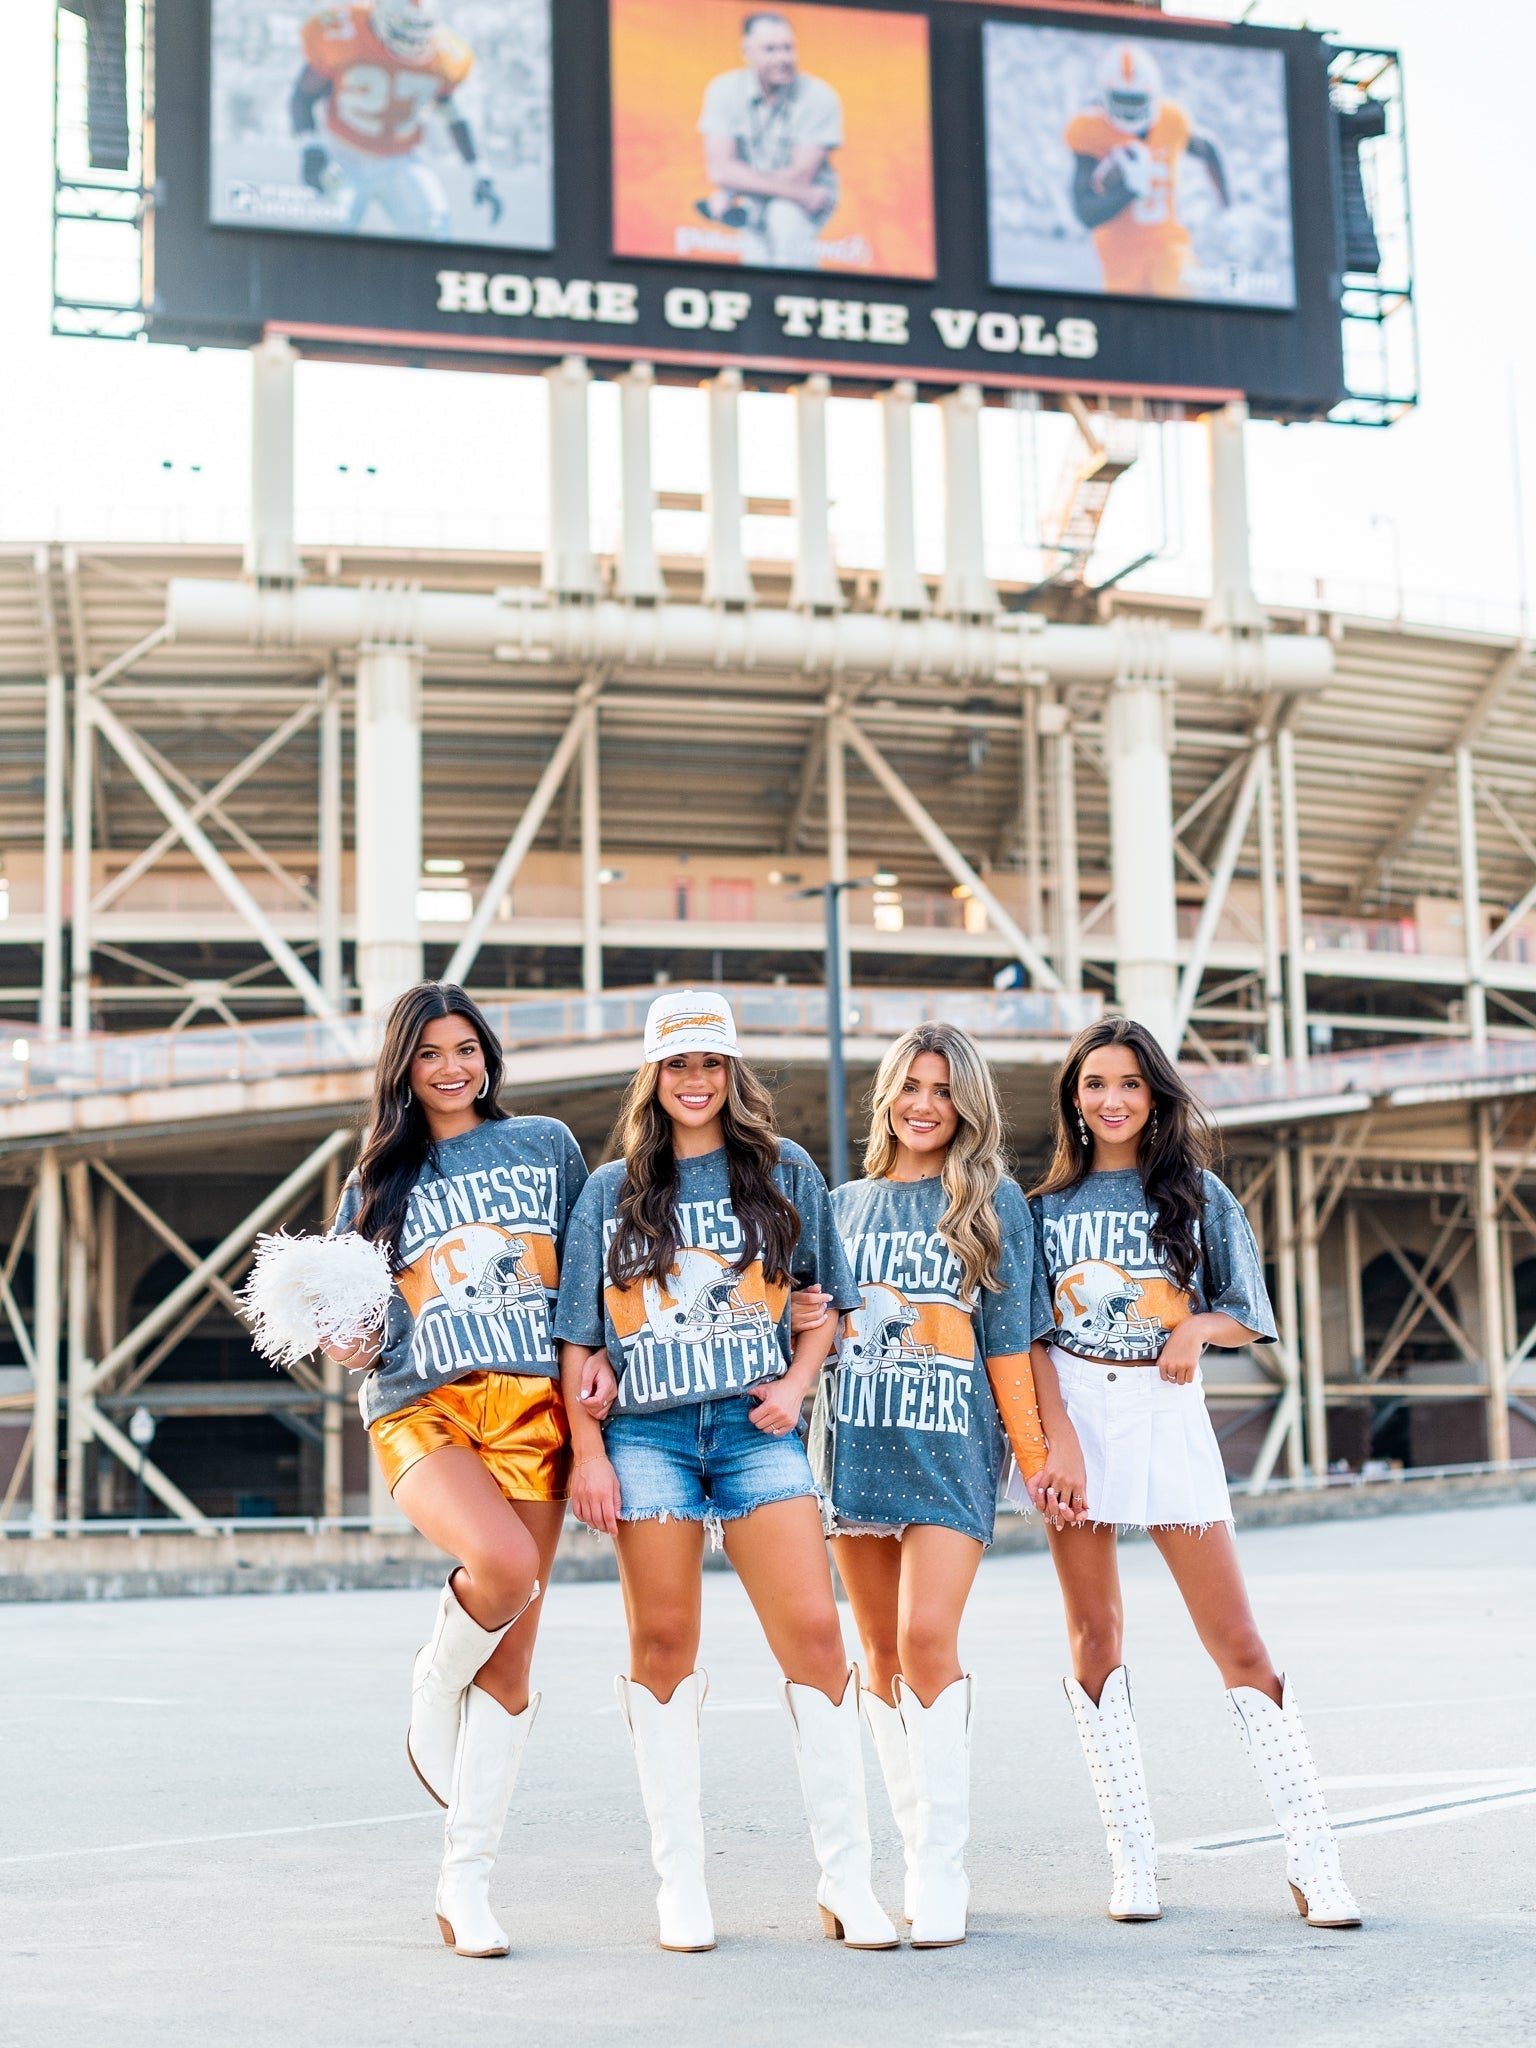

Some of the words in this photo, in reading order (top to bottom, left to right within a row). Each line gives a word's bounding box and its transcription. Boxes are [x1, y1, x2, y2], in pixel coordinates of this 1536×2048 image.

[336, 64, 440, 138] 27
[436, 270, 639, 325] HOME
[664, 287, 750, 331] OF
[774, 295, 909, 345] THE
[931, 307, 1098, 359] VOLS
